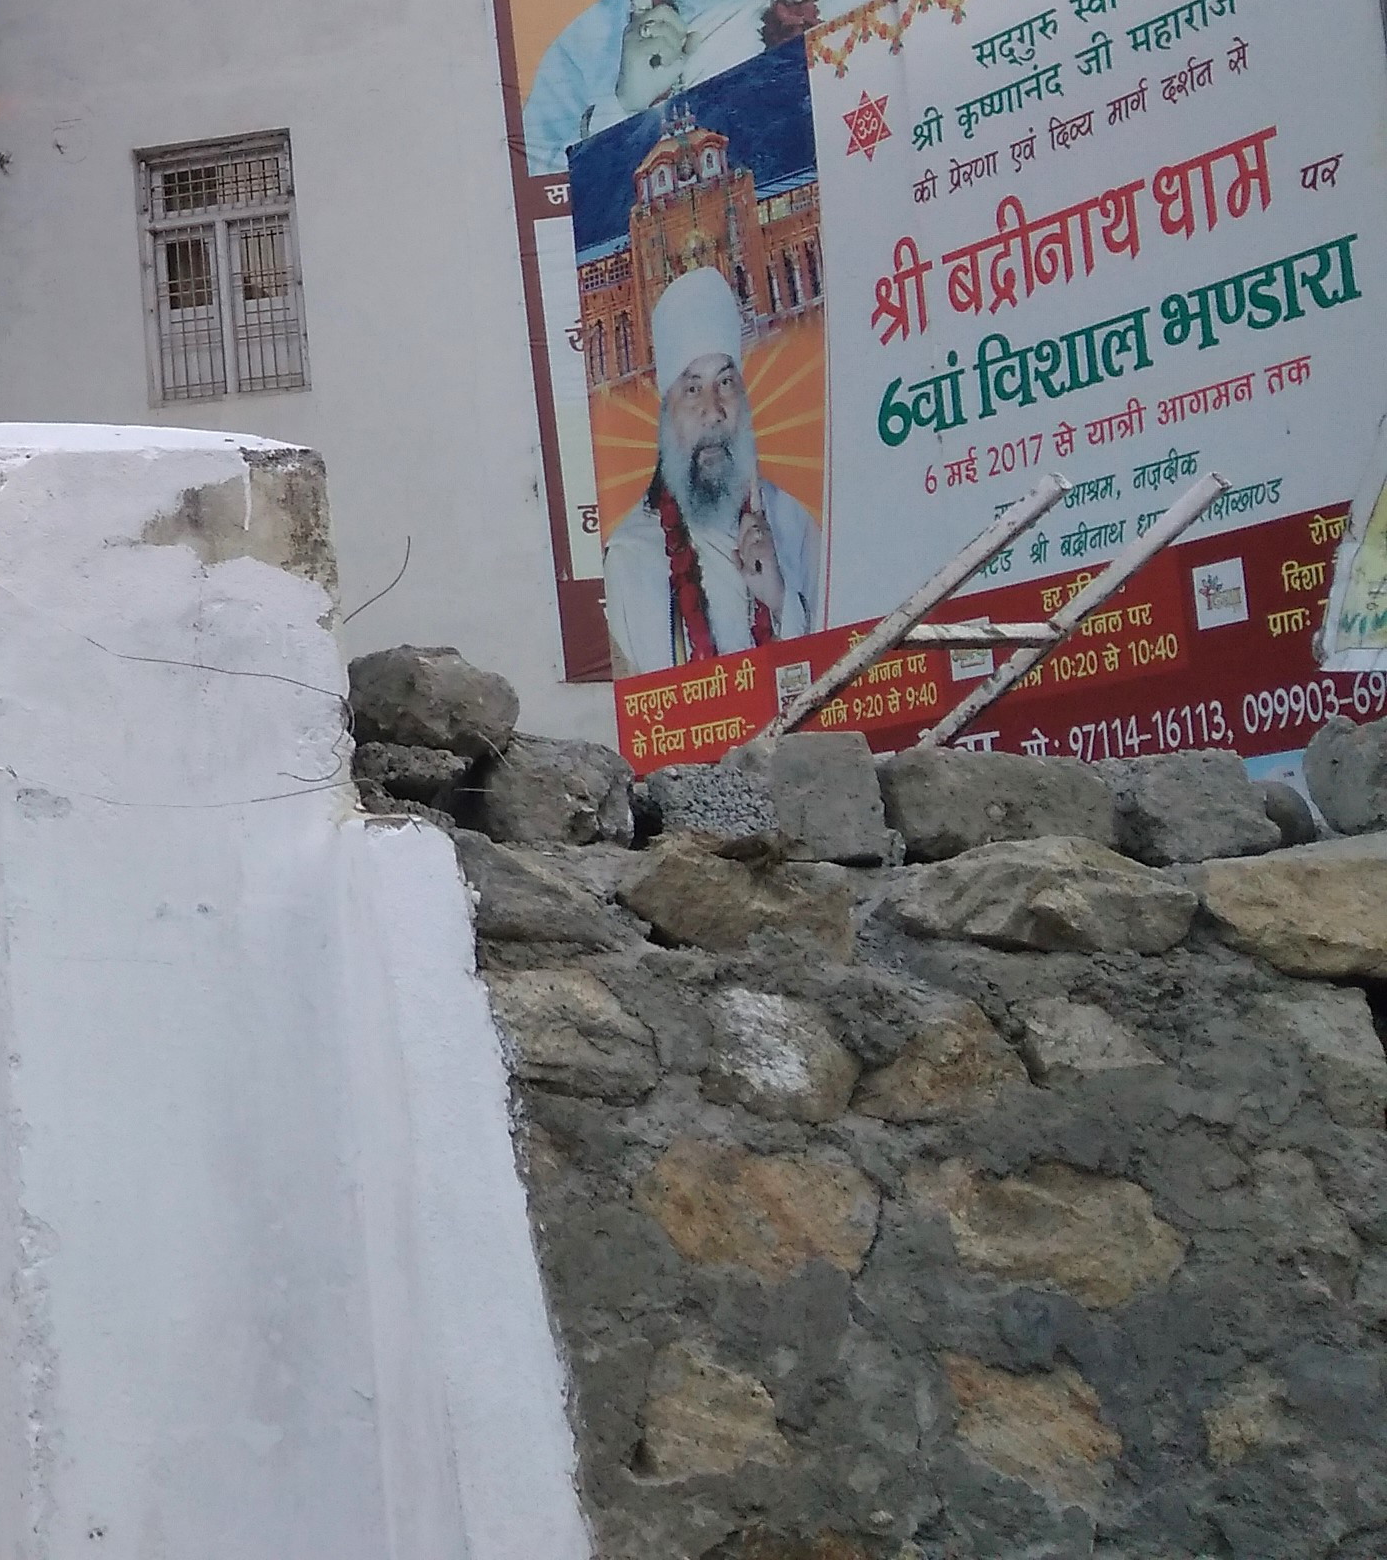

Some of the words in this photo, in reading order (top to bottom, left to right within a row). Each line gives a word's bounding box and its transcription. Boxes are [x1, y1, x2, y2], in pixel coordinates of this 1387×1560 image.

[972, 8, 1058, 69] सद्गुरु
[911, 106, 944, 152] श्री
[955, 62, 1065, 140] कृष्णानंद
[1075, 30, 1113, 77] जी
[913, 169, 938, 205] की
[948, 149, 999, 194] प्रेरणा
[1010, 126, 1038, 174] एवं
[1049, 109, 1095, 151] दिव्य
[1106, 78, 1148, 127] मार्ग
[1161, 56, 1215, 104] दर्शन
[1226, 36, 1249, 76] से
[870, 236, 934, 347] श्री
[942, 178, 1146, 316] बद्रीनाथ
[1152, 125, 1278, 240] धाम
[1299, 153, 1345, 192] पर
[877, 352, 969, 447] 6वां
[973, 305, 1154, 420] विशाल
[1160, 233, 1363, 350] भण्डारा
[924, 463, 938, 494] 6
[943, 446, 979, 488] मई
[987, 433, 1044, 477] 2017
[1052, 421, 1078, 458] से
[1085, 397, 1147, 447] यात्री
[1157, 371, 1255, 426] आगमन
[1263, 354, 1312, 395] तक
[1030, 532, 1050, 564] श्री
[1060, 519, 1127, 557] बद्रीनाथ
[1041, 586, 1063, 612] हर
[1282, 560, 1326, 592] दिशा
[1127, 602, 1153, 626] पर
[682, 665, 729, 705] स्वामी
[734, 658, 756, 691] श्री
[867, 659, 903, 684] भजन
[906, 653, 927, 674] पर
[1050, 650, 1098, 682] 10:20
[1102, 642, 1121, 671] से
[1128, 633, 1178, 666] 10:40
[853, 694, 884, 720] 9:20
[887, 687, 901, 714] से
[906, 681, 937, 710] 9:40
[632, 730, 648, 758] के
[651, 724, 686, 755] दिव्य
[1069, 700, 1234, 763] 97114-16113,
